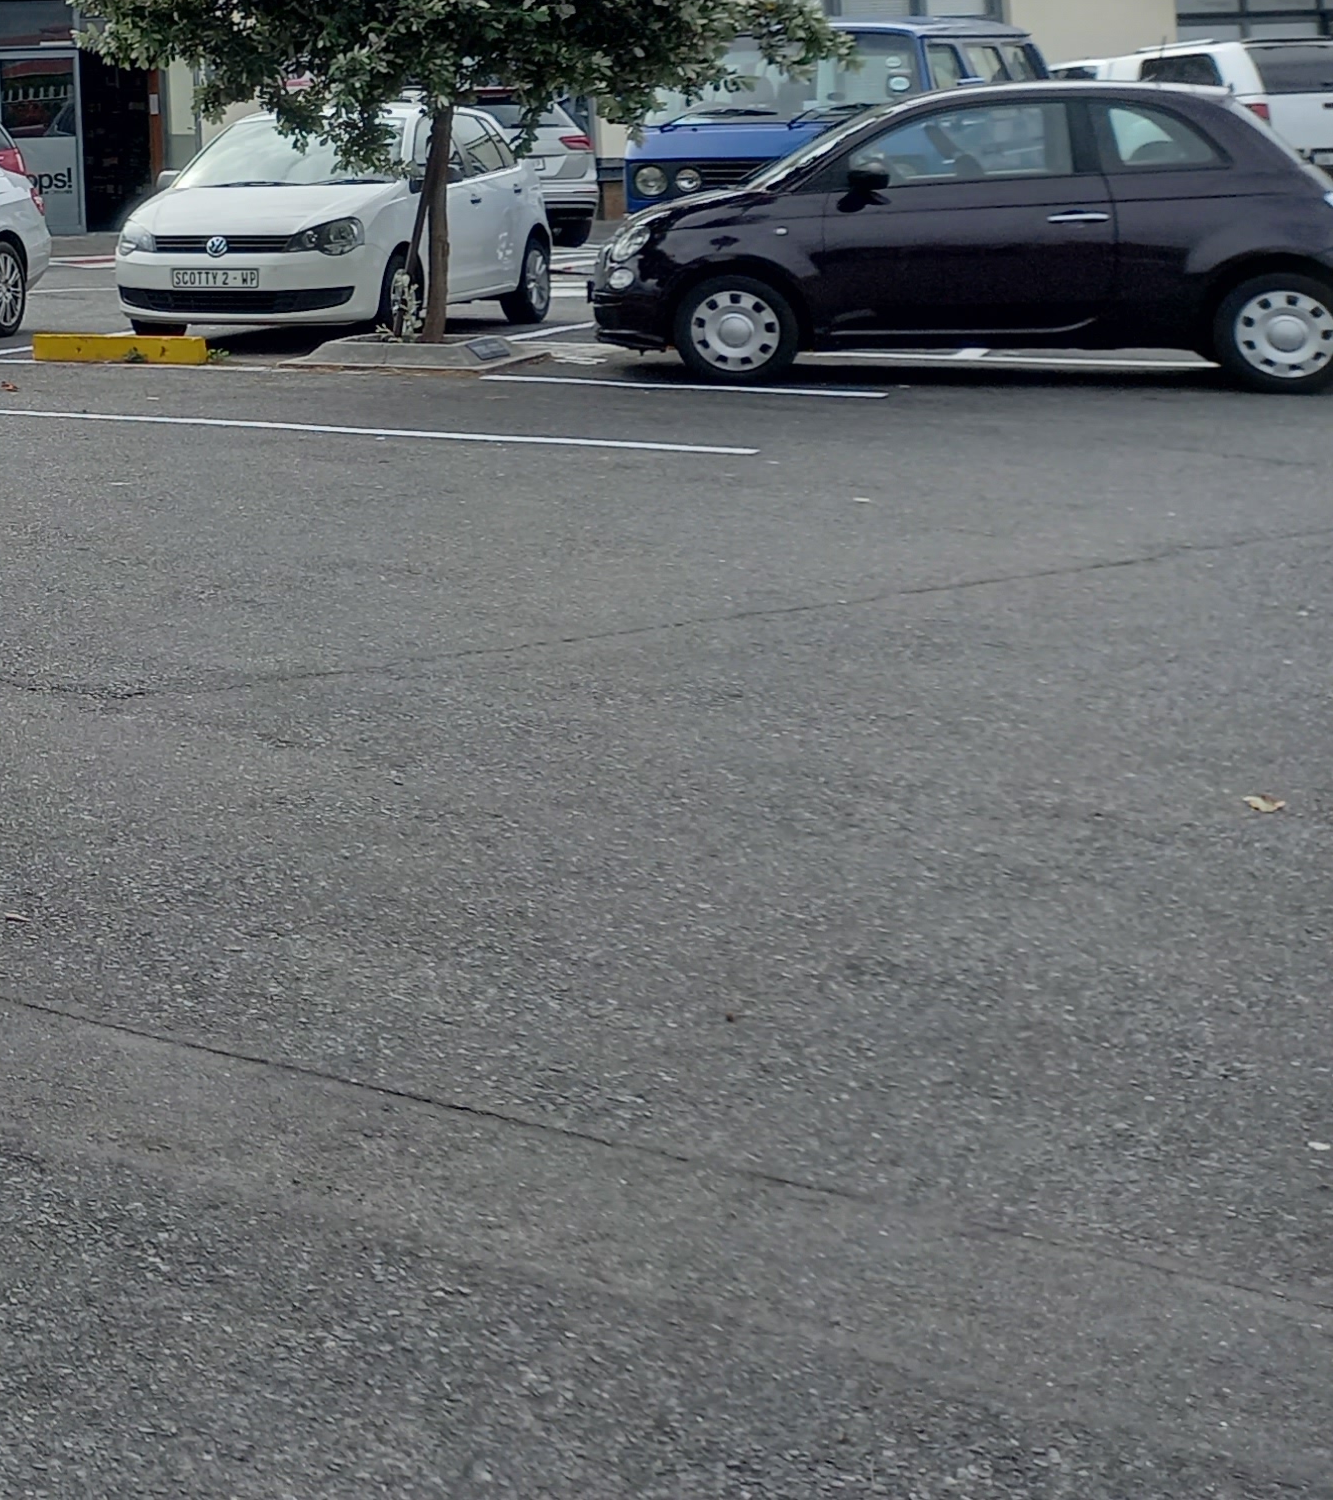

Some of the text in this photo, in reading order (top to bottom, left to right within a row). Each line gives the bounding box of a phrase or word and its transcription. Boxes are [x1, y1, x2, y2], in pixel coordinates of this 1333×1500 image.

[26, 167, 73, 195] ops!
[175, 271, 218, 286] SCOTTY
[222, 271, 229, 286] 2
[241, 271, 257, 285] WP
